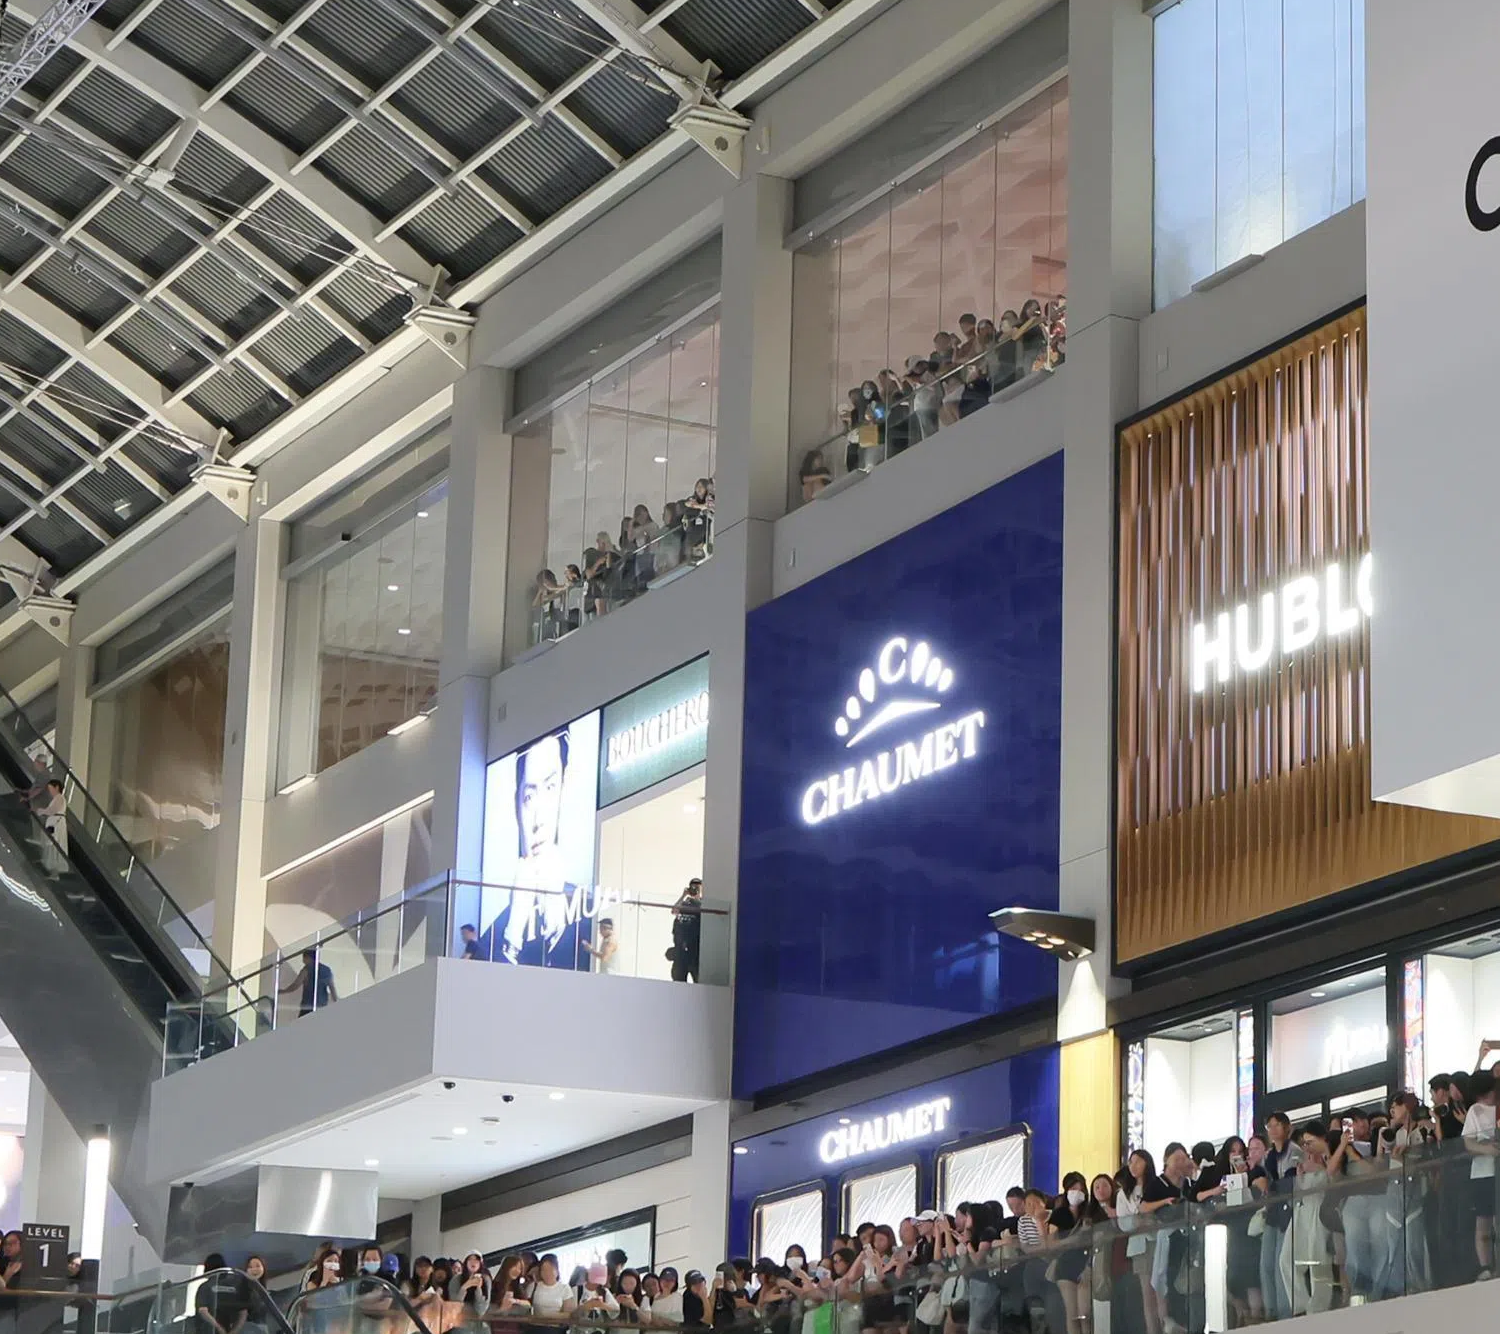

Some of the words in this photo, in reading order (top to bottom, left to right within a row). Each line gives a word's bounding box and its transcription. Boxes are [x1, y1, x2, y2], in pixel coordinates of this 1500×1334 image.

[802, 710, 985, 825] CHAUMET
[819, 1096, 951, 1164] CHAUMET
[27, 1227, 65, 1238] LEVEL
[39, 1243, 49, 1267] 1
